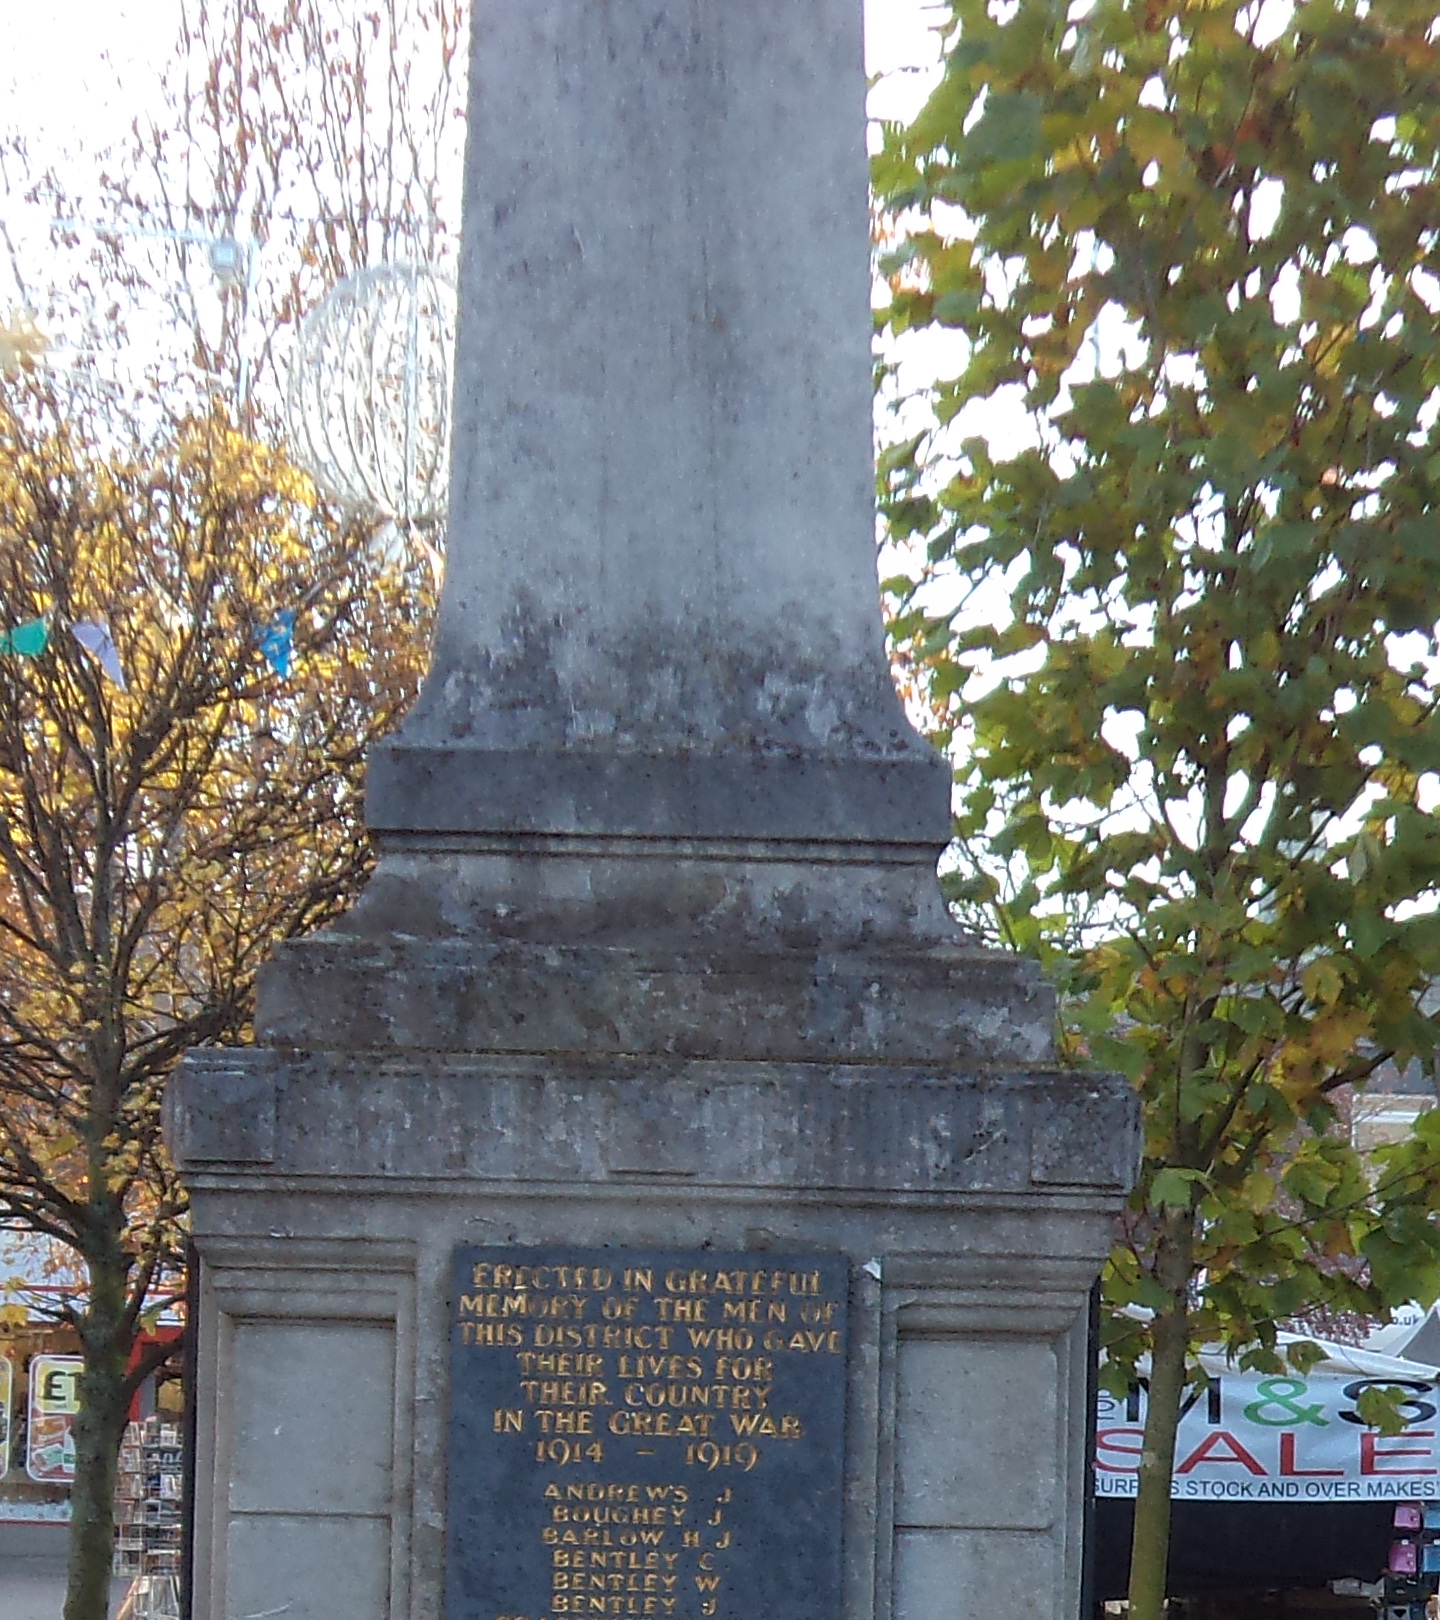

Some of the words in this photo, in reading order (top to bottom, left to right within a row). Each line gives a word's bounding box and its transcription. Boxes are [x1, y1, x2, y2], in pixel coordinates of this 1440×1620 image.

[473, 1262, 613, 1291] ERECTED
[624, 1267, 653, 1293] IN
[665, 1269, 822, 1296] GRATEFUL
[459, 1293, 588, 1319] MEMORY
[602, 1296, 639, 1320] OF
[654, 1299, 709, 1322] THE
[723, 1300, 787, 1323] MEN
[800, 1302, 839, 1325] OF
[458, 1320, 523, 1347] THIS
[534, 1323, 674, 1350] DISTRICT
[687, 1327, 754, 1350] WHO
[763, 1328, 842, 1354] GAVE
[517, 1352, 605, 1377] THEIR
[618, 1354, 703, 1379] LIVES
[715, 1356, 774, 1381] FOR
[520, 1381, 613, 1405] THEIR
[1243, 1377, 1330, 1426] &
[1338, 1378, 1437, 1426] S
[493, 1408, 523, 1433] IN
[534, 1409, 595, 1434] THE
[610, 1410, 715, 1436] GREAT
[729, 1411, 804, 1438] WAR
[535, 1439, 604, 1465] 1914
[686, 1441, 760, 1472] 1919
[1095, 1428, 1437, 1476] SALE
[543, 1483, 689, 1503] ANDREWS
[1094, 1478, 1179, 1496] SURPS
[1186, 1480, 1253, 1498] STOCK
[1257, 1482, 1299, 1497] AND
[1305, 1482, 1360, 1497] OVER
[552, 1504, 687, 1525] BOUGHEY
[541, 1527, 664, 1546] BARLOW
[552, 1550, 679, 1570] BENTLEY
[552, 1572, 678, 1592] BENTLEY
[551, 1595, 678, 1615] BENTLEY
